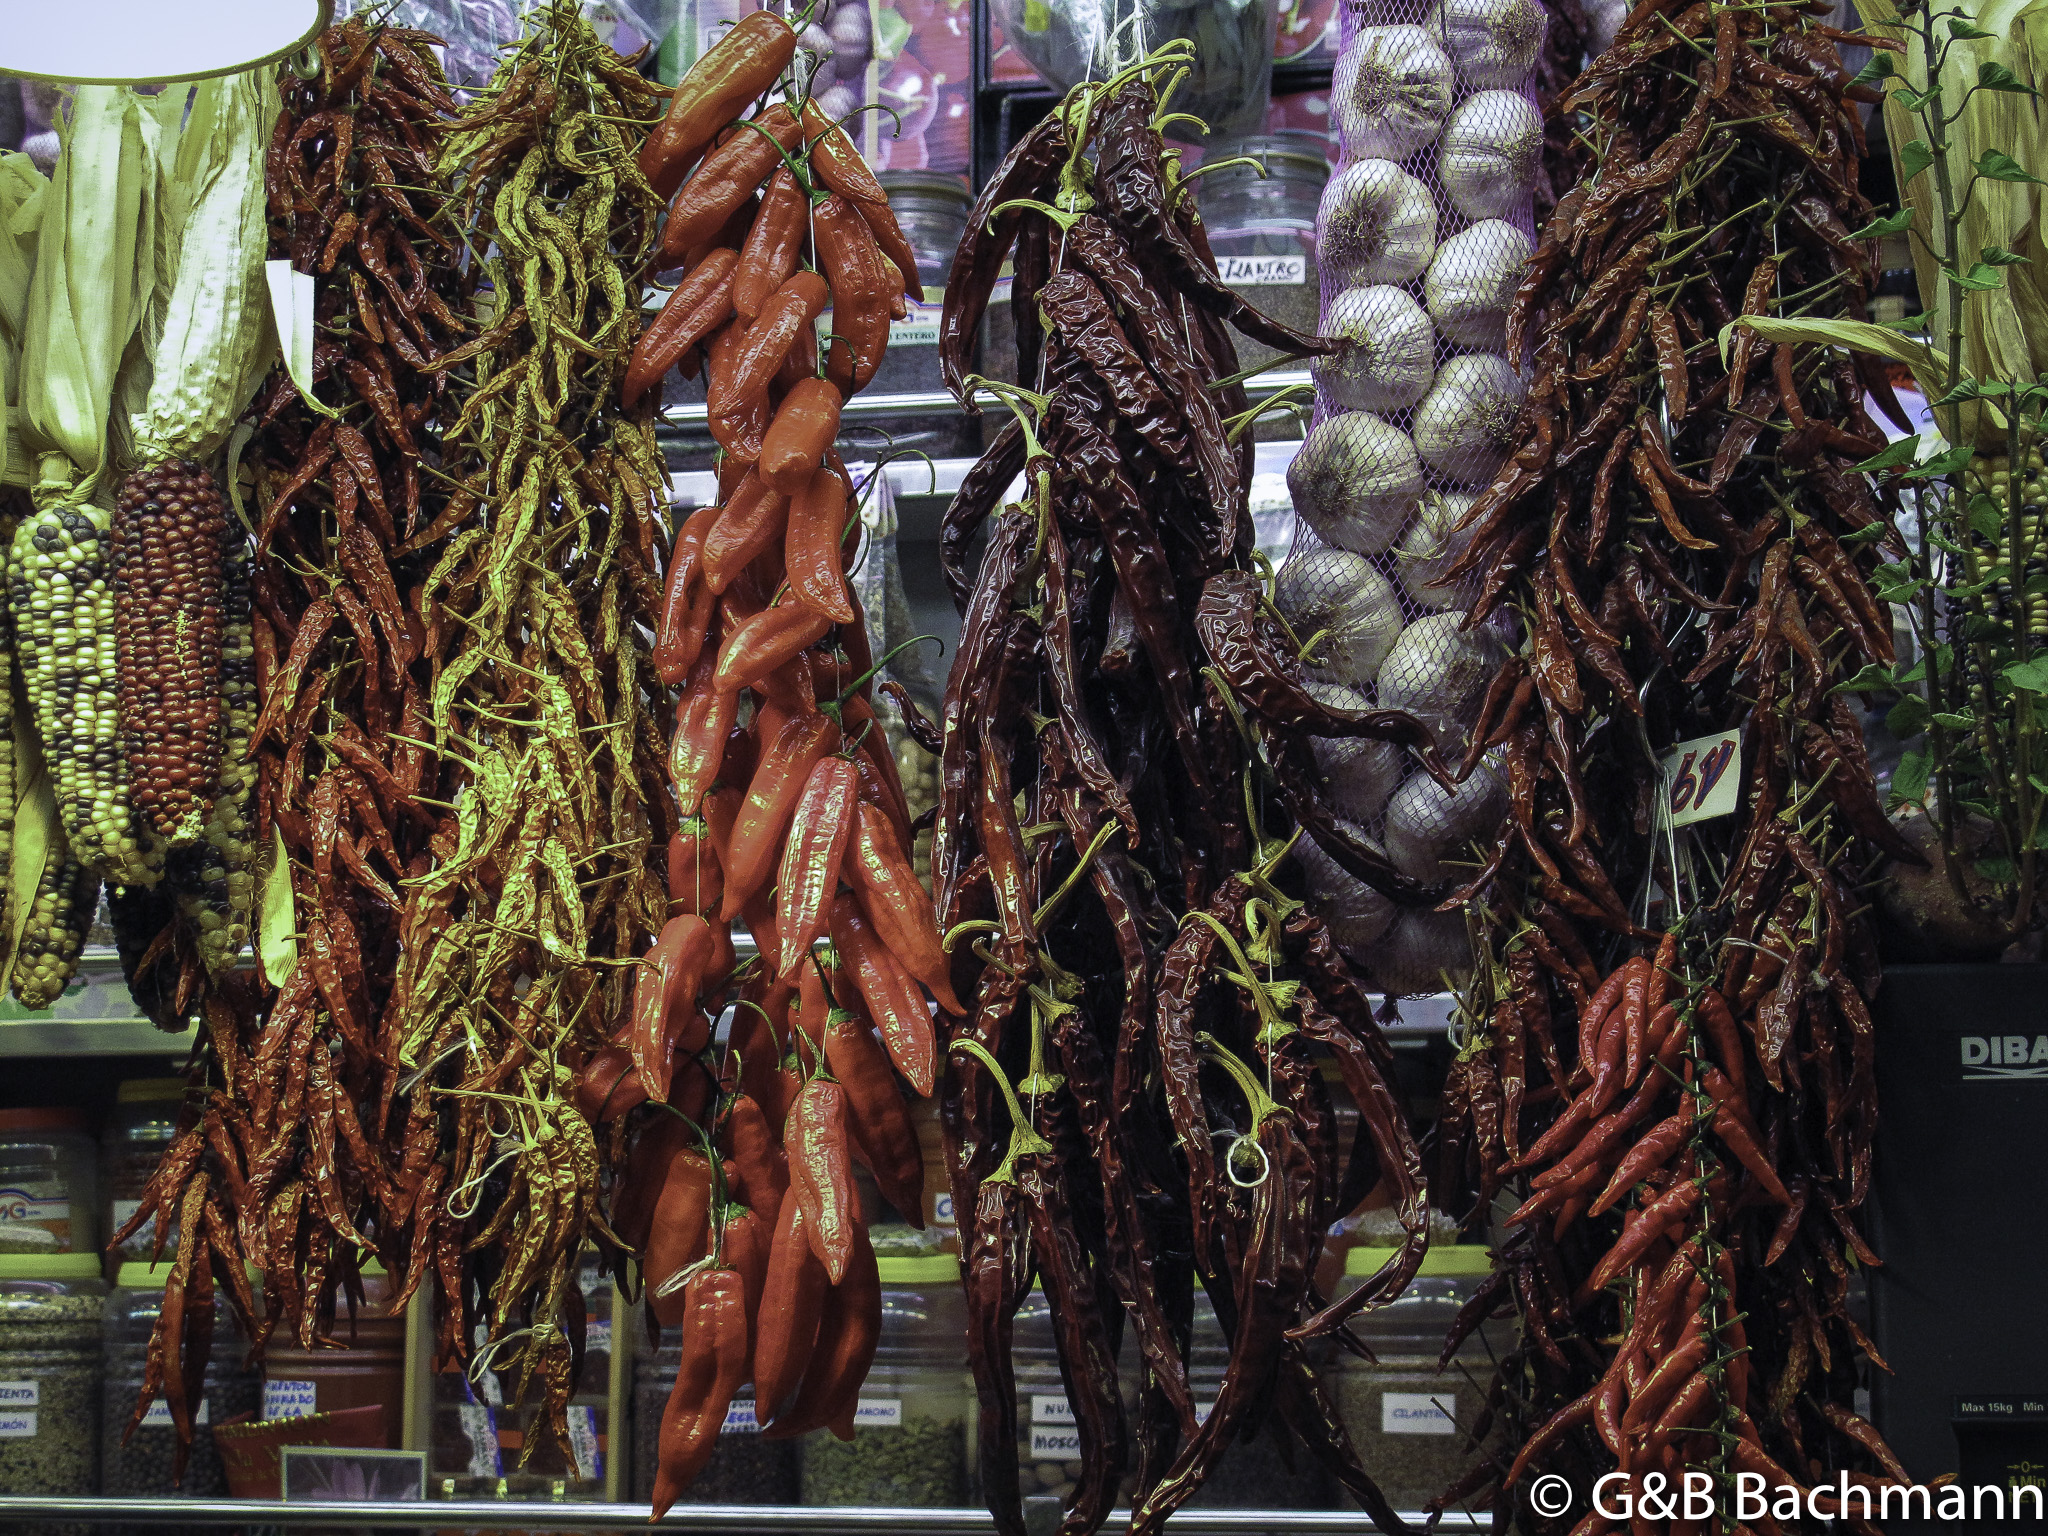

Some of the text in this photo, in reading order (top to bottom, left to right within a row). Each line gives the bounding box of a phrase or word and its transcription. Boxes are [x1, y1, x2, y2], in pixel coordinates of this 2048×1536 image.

[1217, 256, 1300, 278] ILANTRO
[1961, 1402, 2044, 1413] Max 15kg Min
